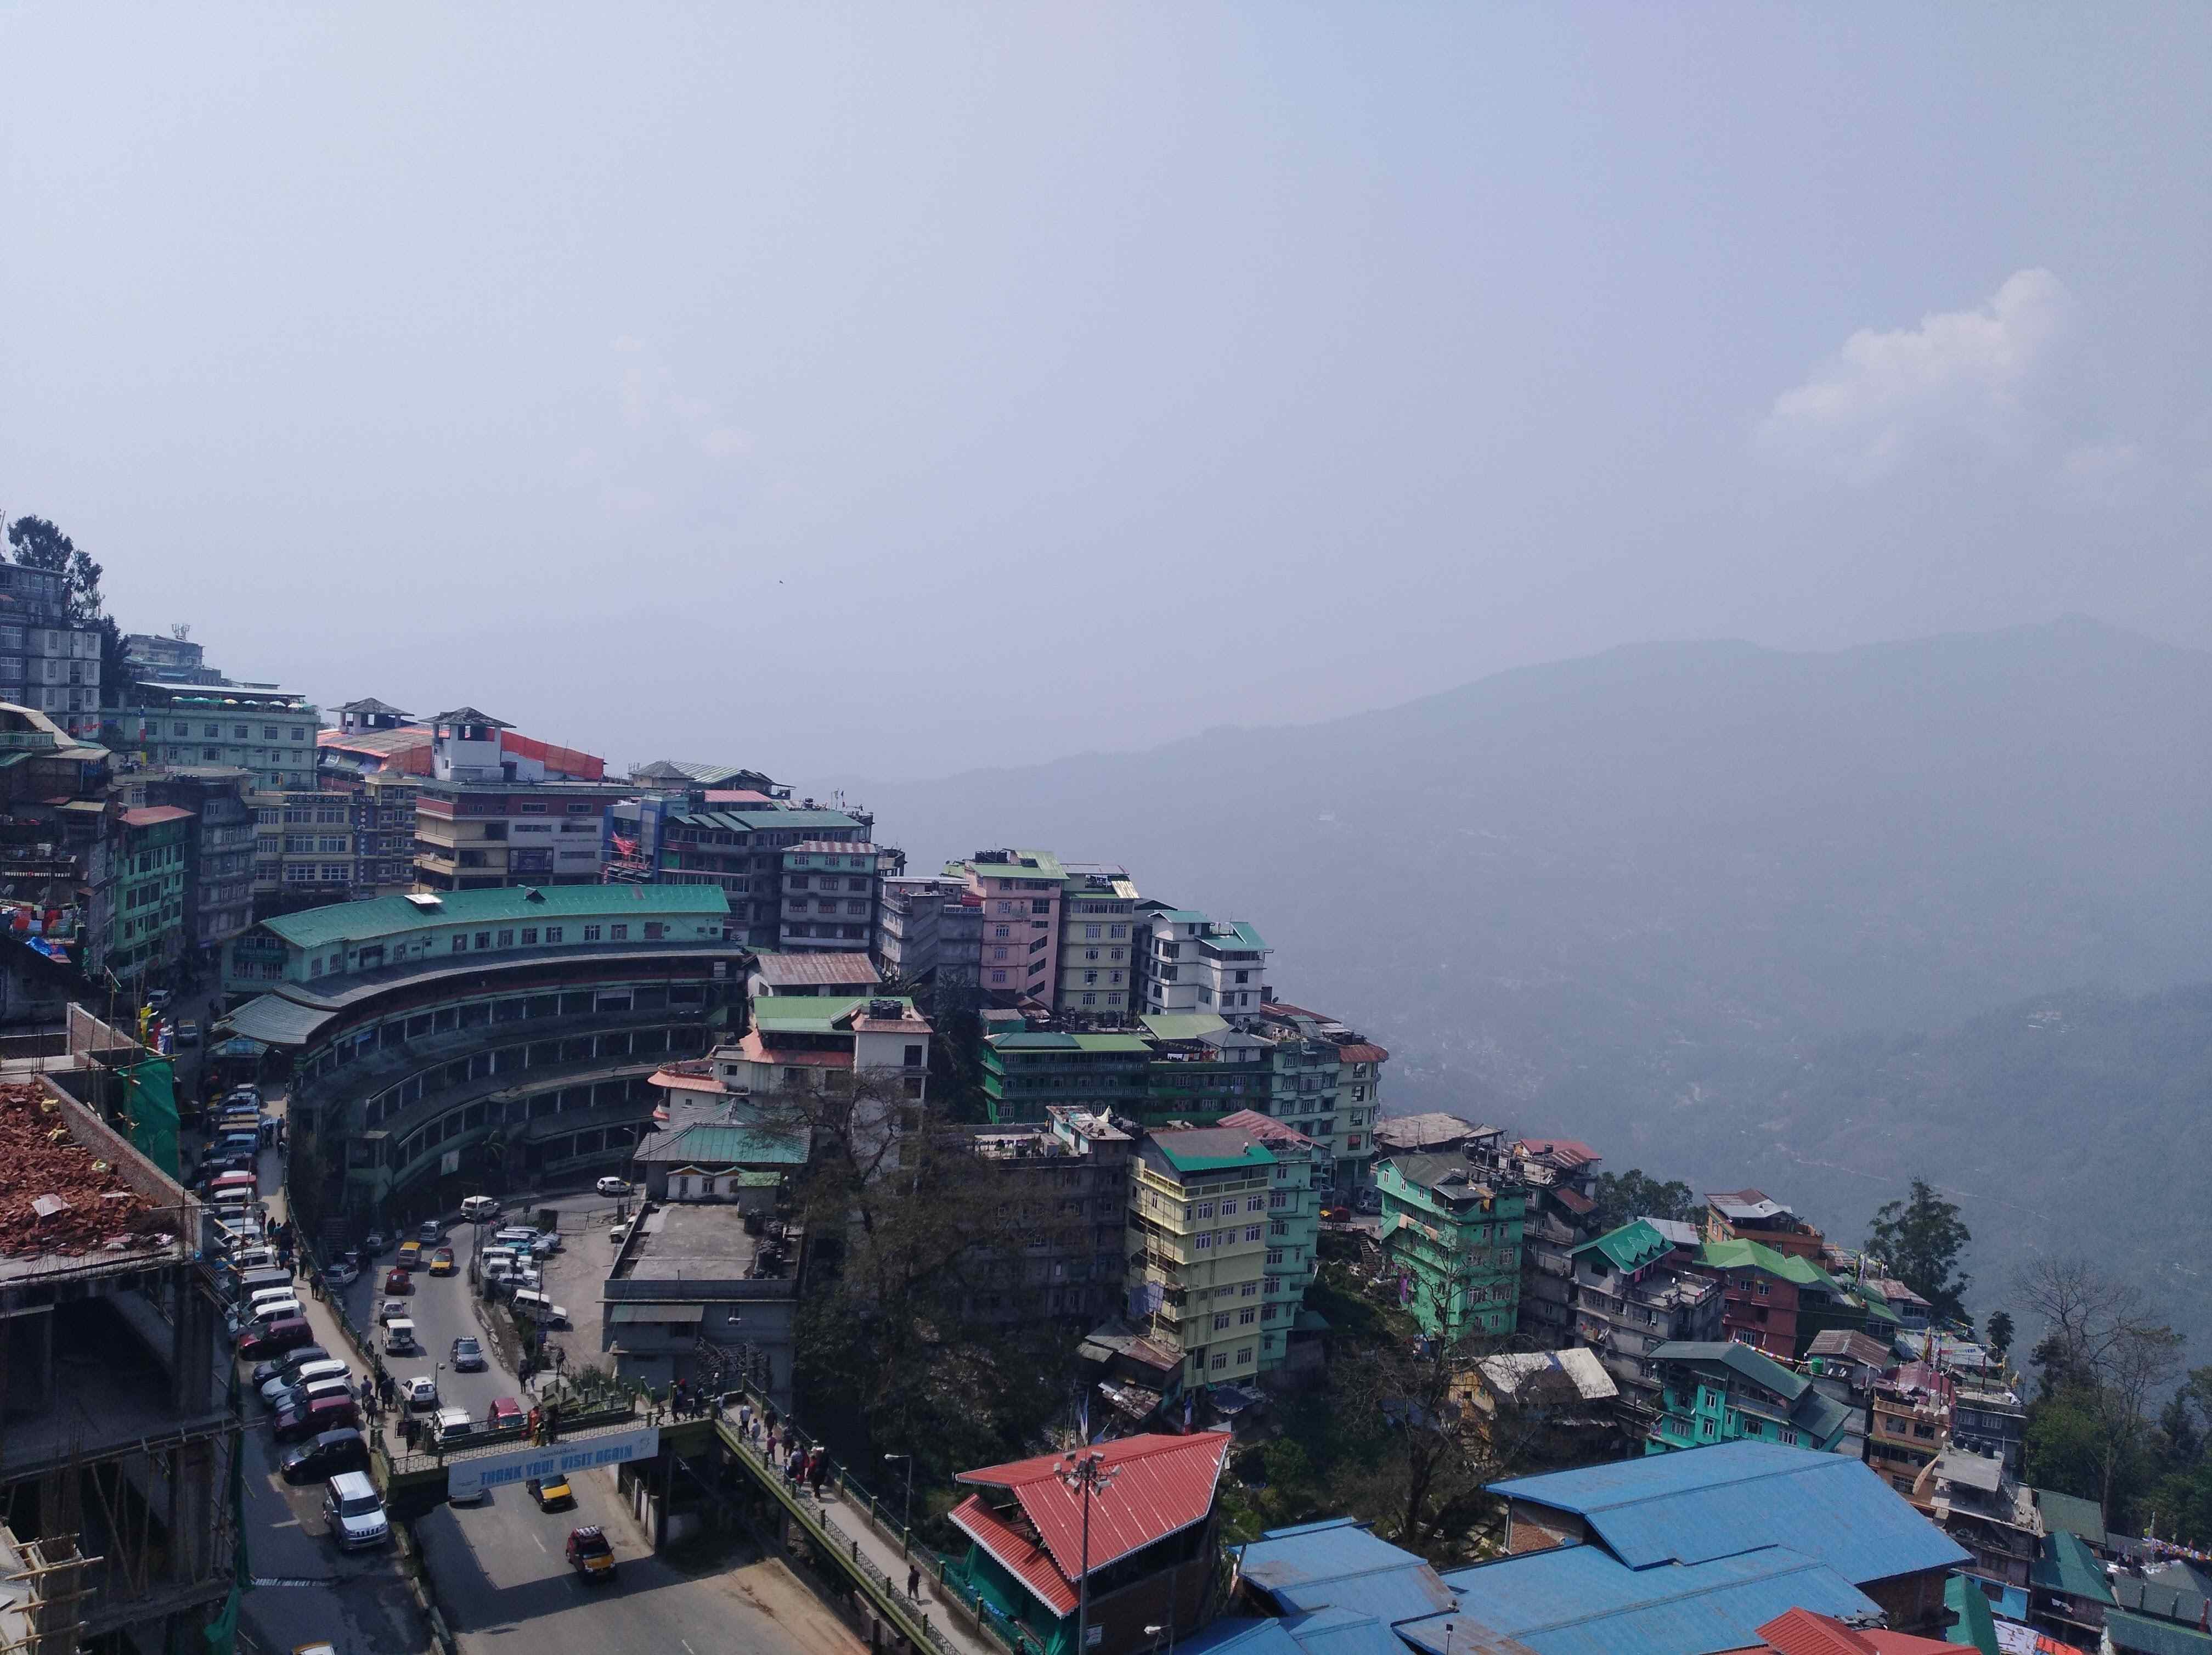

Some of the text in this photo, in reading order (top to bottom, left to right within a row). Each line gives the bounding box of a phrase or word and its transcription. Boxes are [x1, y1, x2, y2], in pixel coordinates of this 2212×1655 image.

[481, 1465, 522, 1485] THANK
[526, 1459, 554, 1476] YOU!
[561, 1452, 593, 1471] VISIT
[596, 1445, 632, 1463] AGAIN
